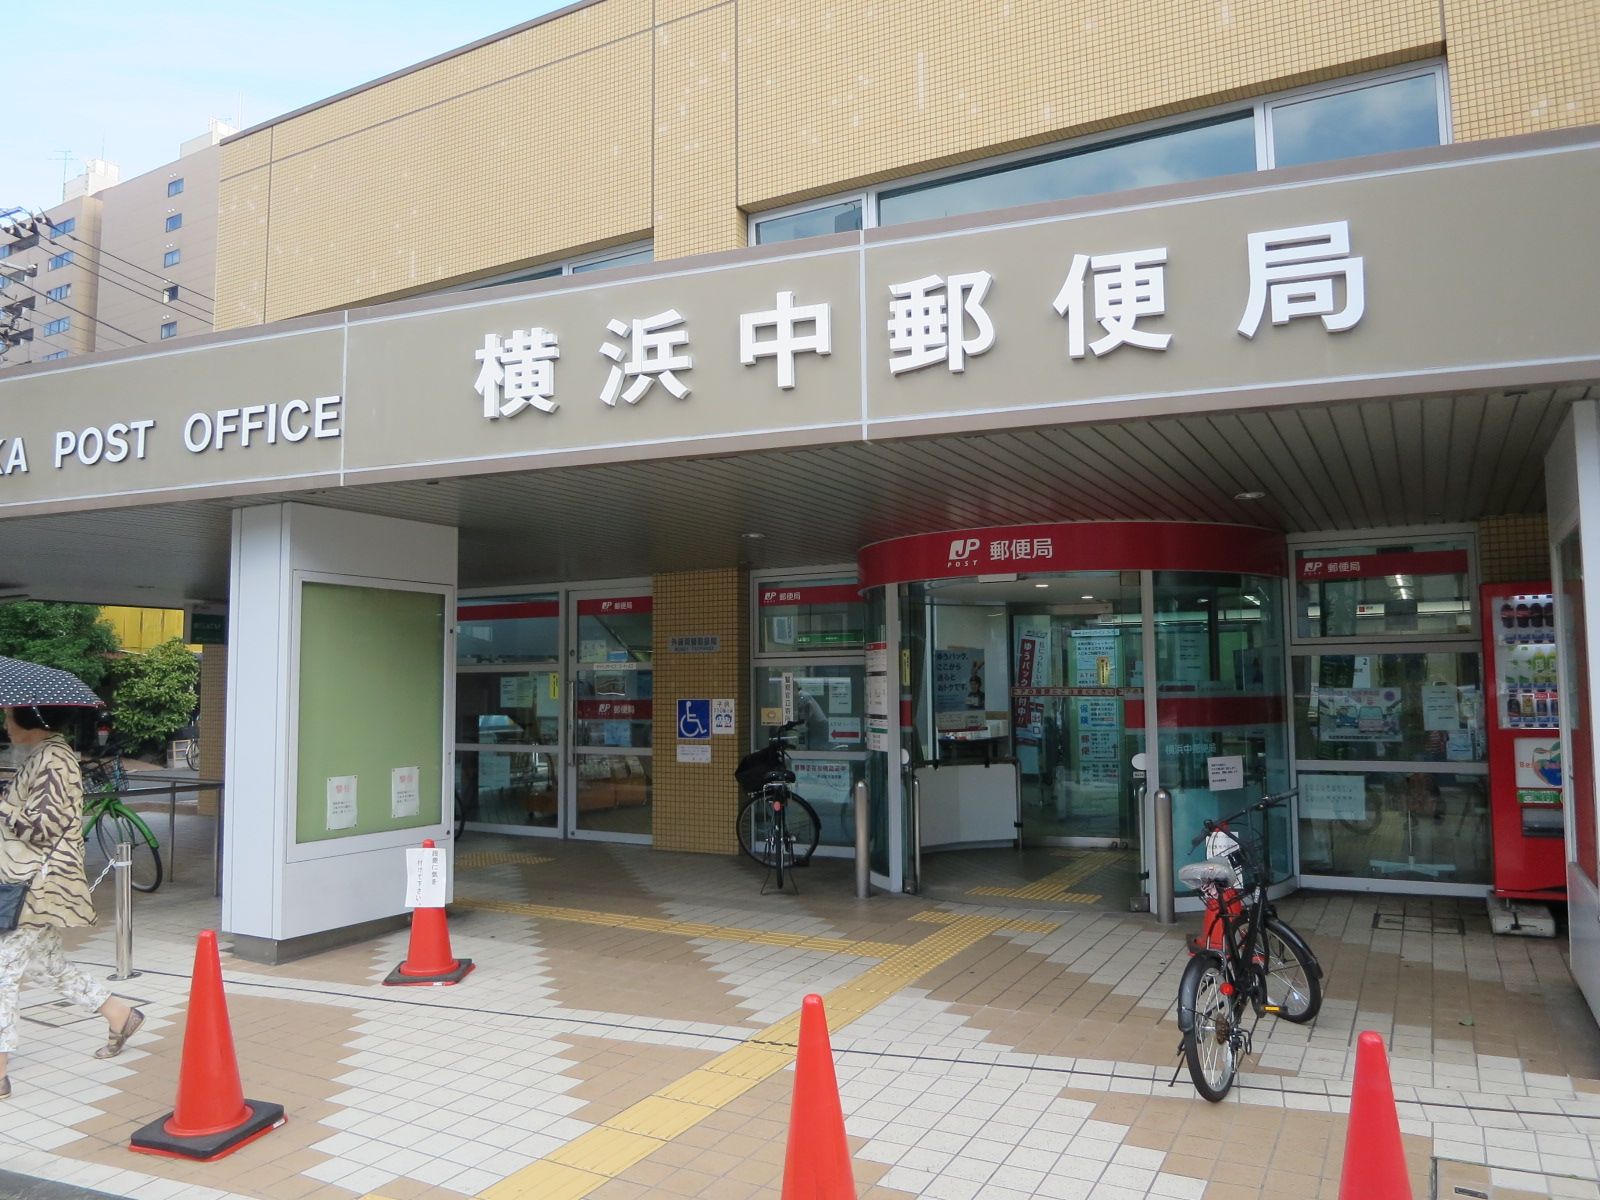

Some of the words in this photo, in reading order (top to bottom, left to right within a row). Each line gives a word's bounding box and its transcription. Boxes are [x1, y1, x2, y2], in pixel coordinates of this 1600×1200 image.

[473, 219, 1364, 420] 横浜中郵便局
[54, 419, 155, 469] POST
[184, 395, 341, 454] OFFICE
[990, 538, 1052, 560] 郵便局
[947, 560, 978, 568] POST
[1328, 562, 1360, 572] 郵便局
[779, 592, 800, 600] 郵便局
